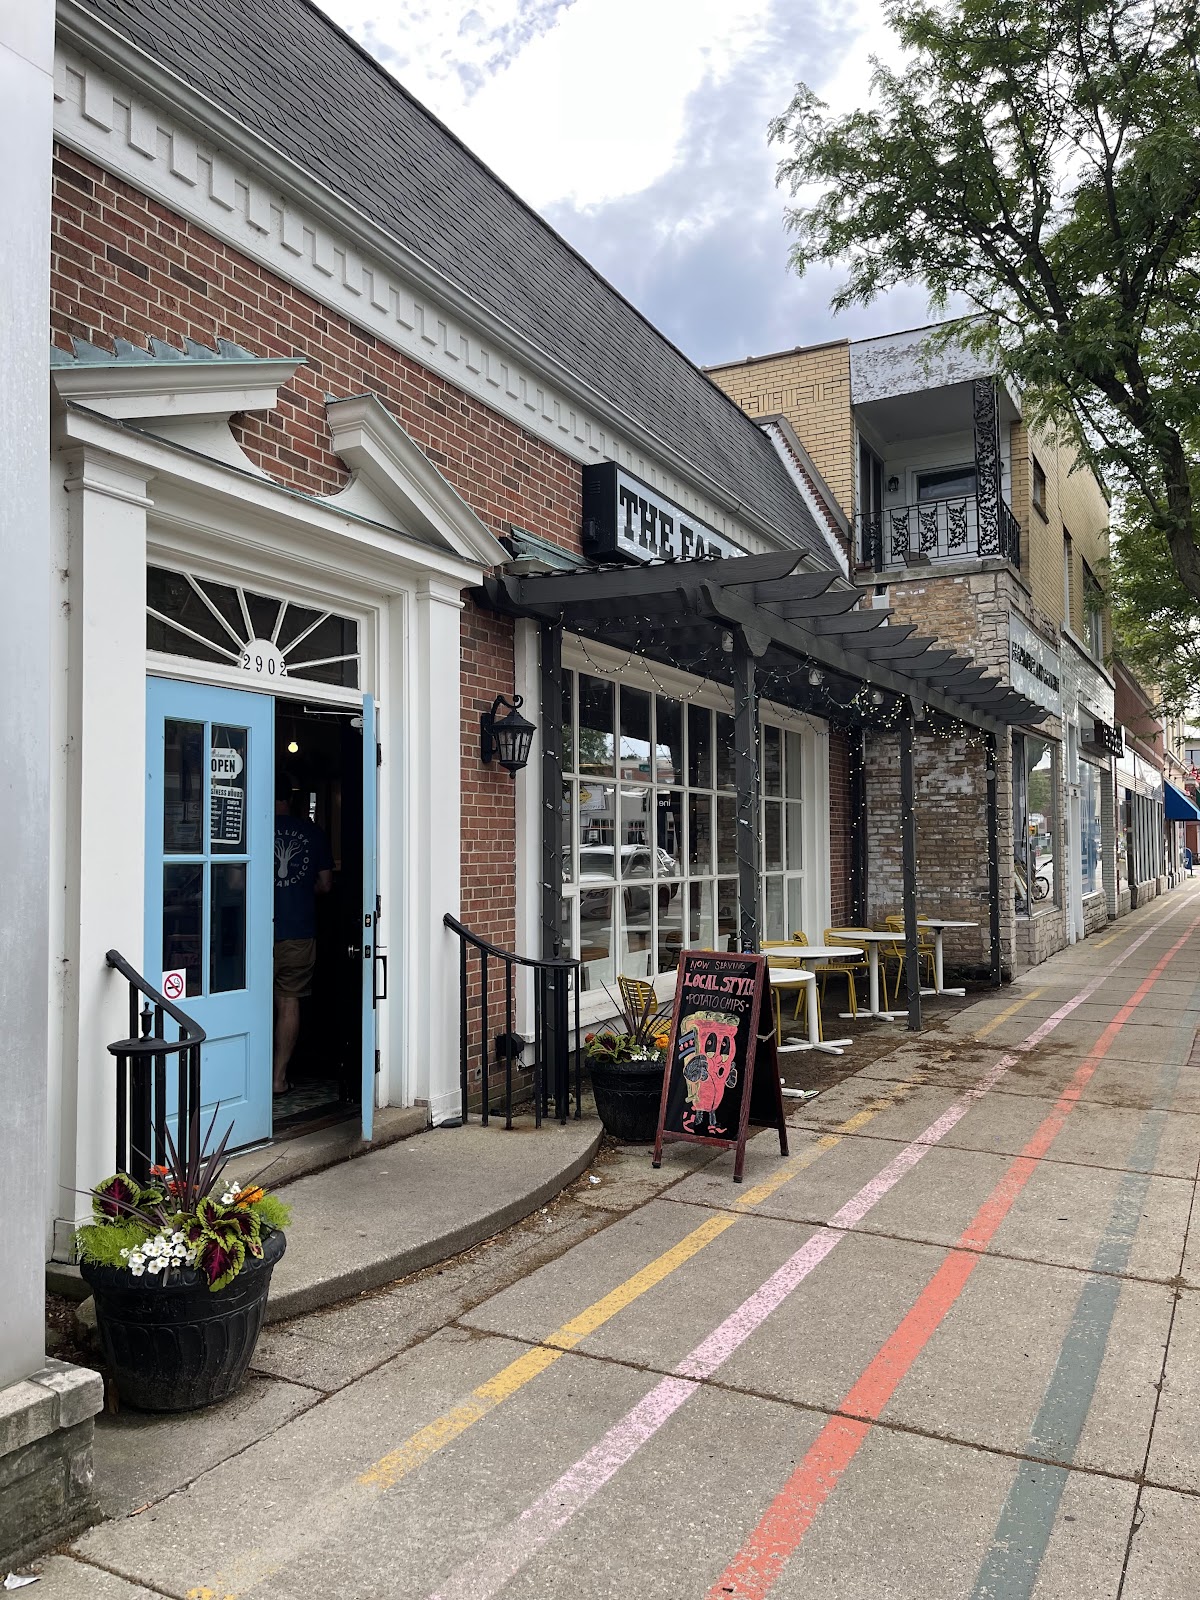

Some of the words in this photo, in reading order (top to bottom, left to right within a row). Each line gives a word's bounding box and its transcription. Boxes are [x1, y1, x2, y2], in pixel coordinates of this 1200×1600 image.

[619, 484, 674, 559] THE
[242, 653, 287, 677] 2902
[211, 758, 236, 773] OPEN
[276, 829, 310, 846] LLUSK
[275, 856, 310, 888] ANCISCO
[690, 960, 710, 970] NOW
[714, 961, 746, 970] SERVING
[683, 972, 720, 991] LOCAL
[719, 976, 756, 996] STYLE
[688, 993, 719, 1008] POTATO
[719, 996, 746, 1013] CHIPS
